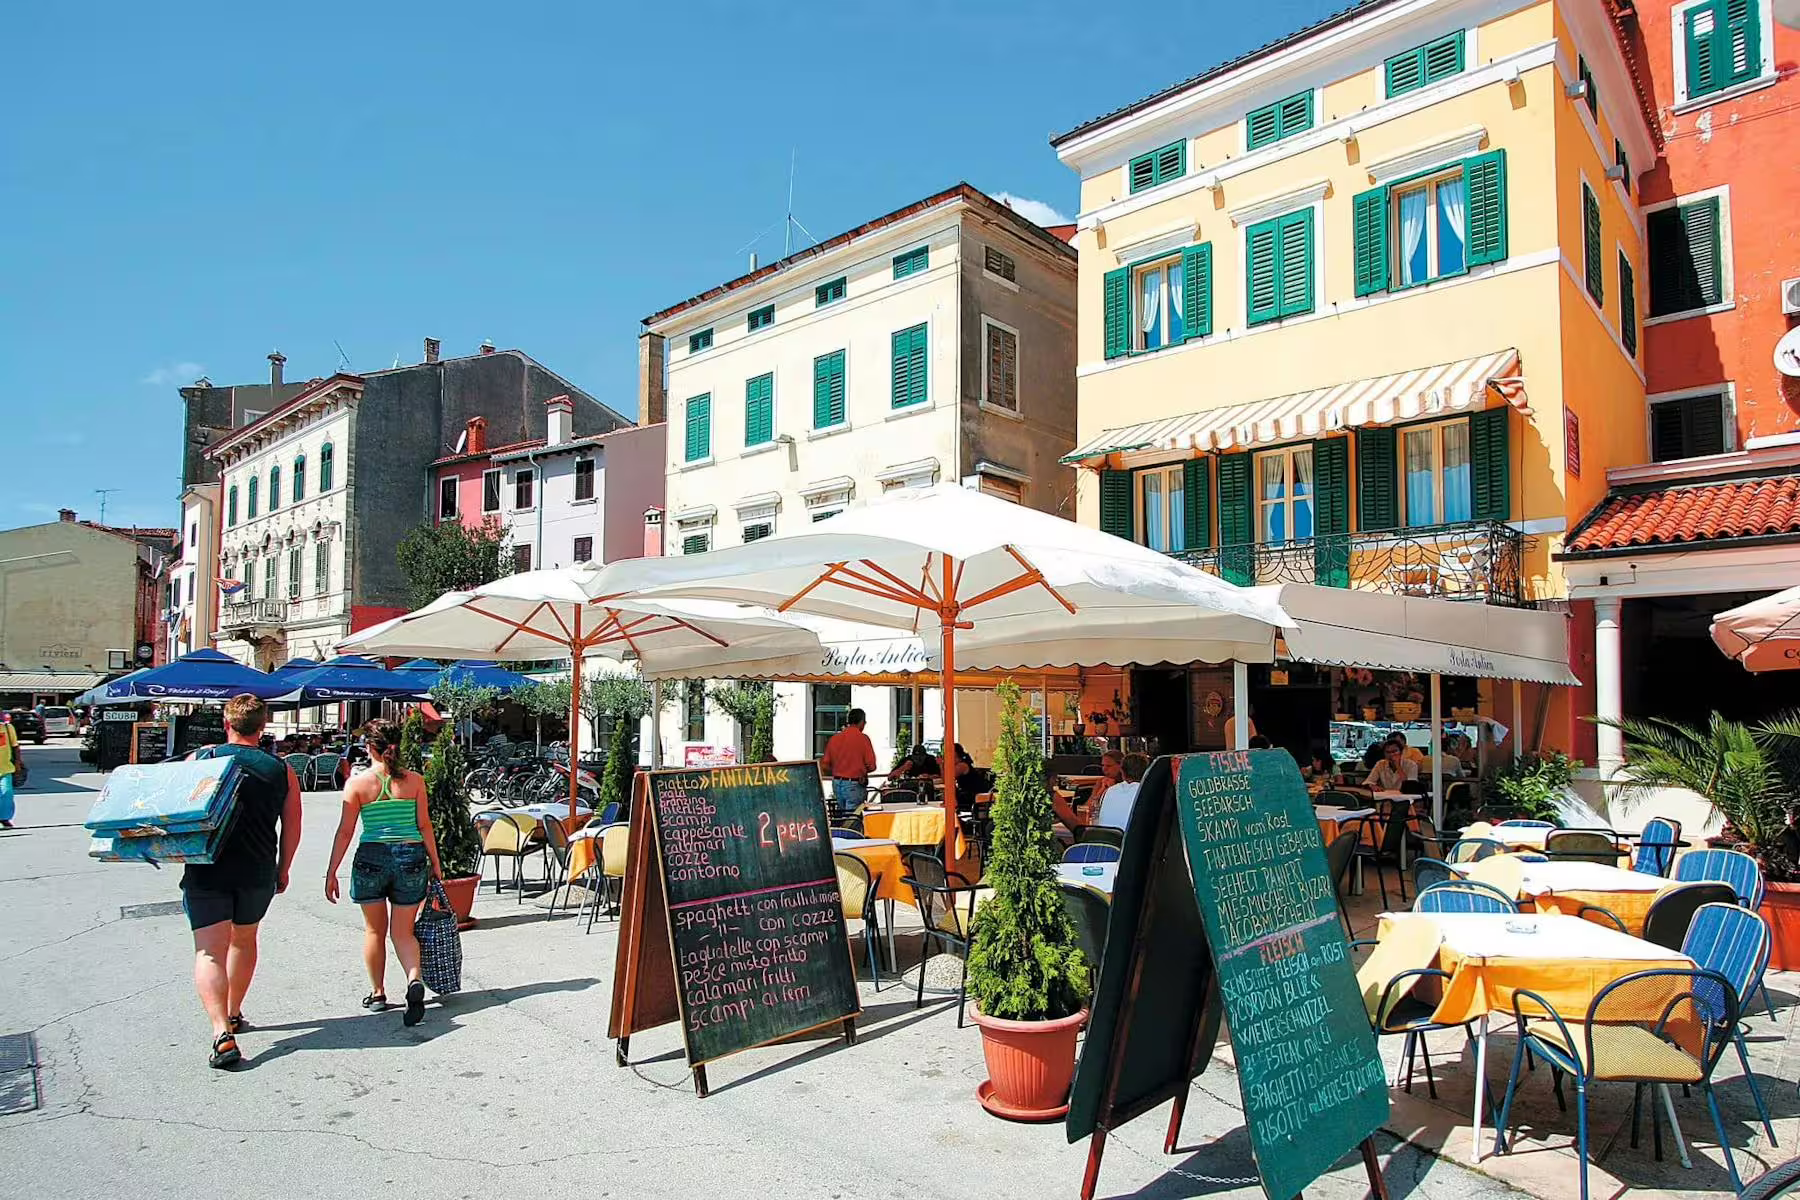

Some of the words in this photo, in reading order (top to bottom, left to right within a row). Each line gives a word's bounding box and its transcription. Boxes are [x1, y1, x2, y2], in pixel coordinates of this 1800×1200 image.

[104, 711, 137, 720] SCUBA
[1209, 752, 1253, 774] FISCHE
[1188, 774, 1251, 799] GOLDBRASSE
[660, 815, 712, 828] scampi
[757, 811, 775, 844] 2
[776, 821, 819, 857] pers
[1197, 818, 1241, 843] SKAMPI
[664, 823, 748, 851] cappesante
[668, 852, 710, 867] cozze
[676, 898, 755, 930] spaghetti
[757, 898, 778, 912] con
[759, 916, 786, 931] con
[792, 908, 838, 927] cozze
[756, 938, 781, 952] con
[783, 930, 830, 948] scampi
[1260, 932, 1305, 966] FLEISCH
[683, 963, 727, 990] pesce
[730, 954, 770, 973] misto
[1274, 951, 1310, 980] FLEISCH
[1320, 942, 1345, 965] ROST
[686, 978, 758, 1007] calamari
[689, 998, 755, 1032] scampi
[1249, 1067, 1308, 1111] SPAGHETTI
[1256, 1097, 1309, 1147] RISOTTO
